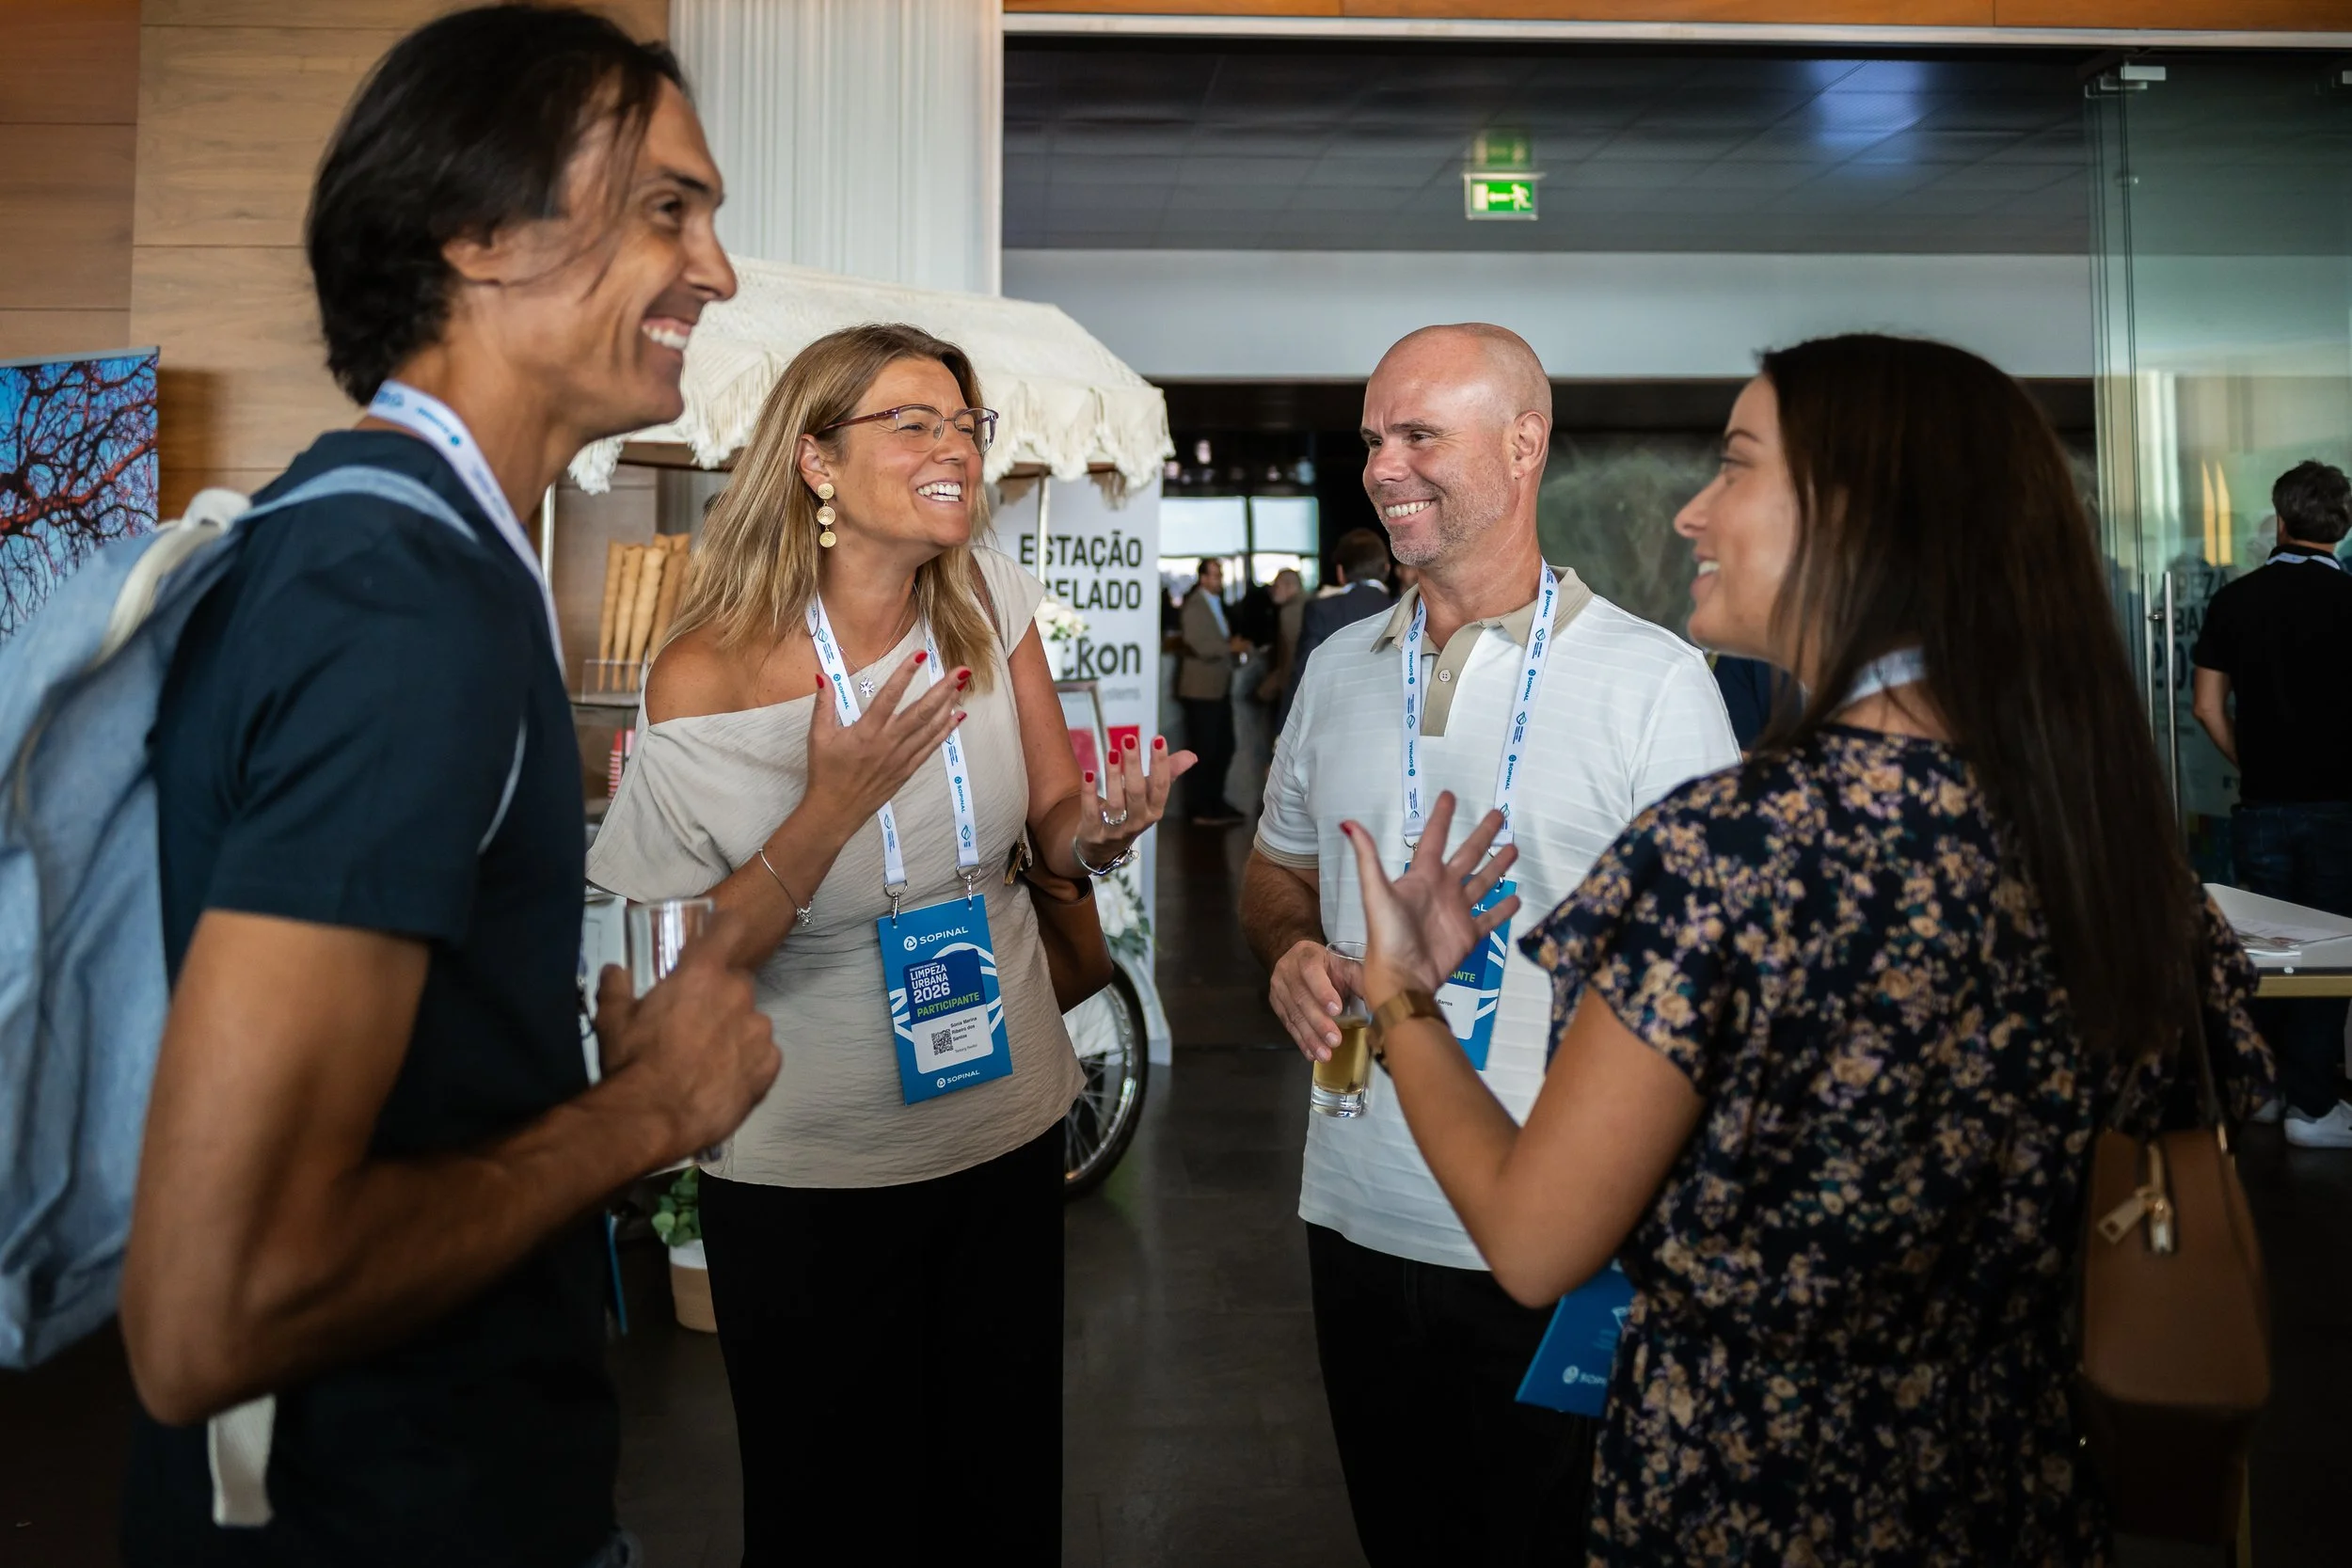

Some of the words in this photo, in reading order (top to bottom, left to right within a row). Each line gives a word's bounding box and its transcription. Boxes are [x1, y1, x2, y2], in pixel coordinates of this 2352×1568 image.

[1045, 578, 1141, 610] ELADO
[1543, 595, 1551, 618] SOPINAL
[836, 682, 850, 710] SOPINAL
[1523, 676, 1534, 702] SOPINAL
[1504, 762, 1514, 791] SOPINAL
[957, 784, 965, 814] SOPINAL
[919, 927, 969, 944] SOPINAL
[910, 963, 947, 981] LIMPEZA
[912, 973, 948, 990] URBANA
[914, 981, 950, 1004] 2026
[916, 991, 980, 1018] PARTICIPANTE
[946, 1069, 980, 1084] SOPINAL
